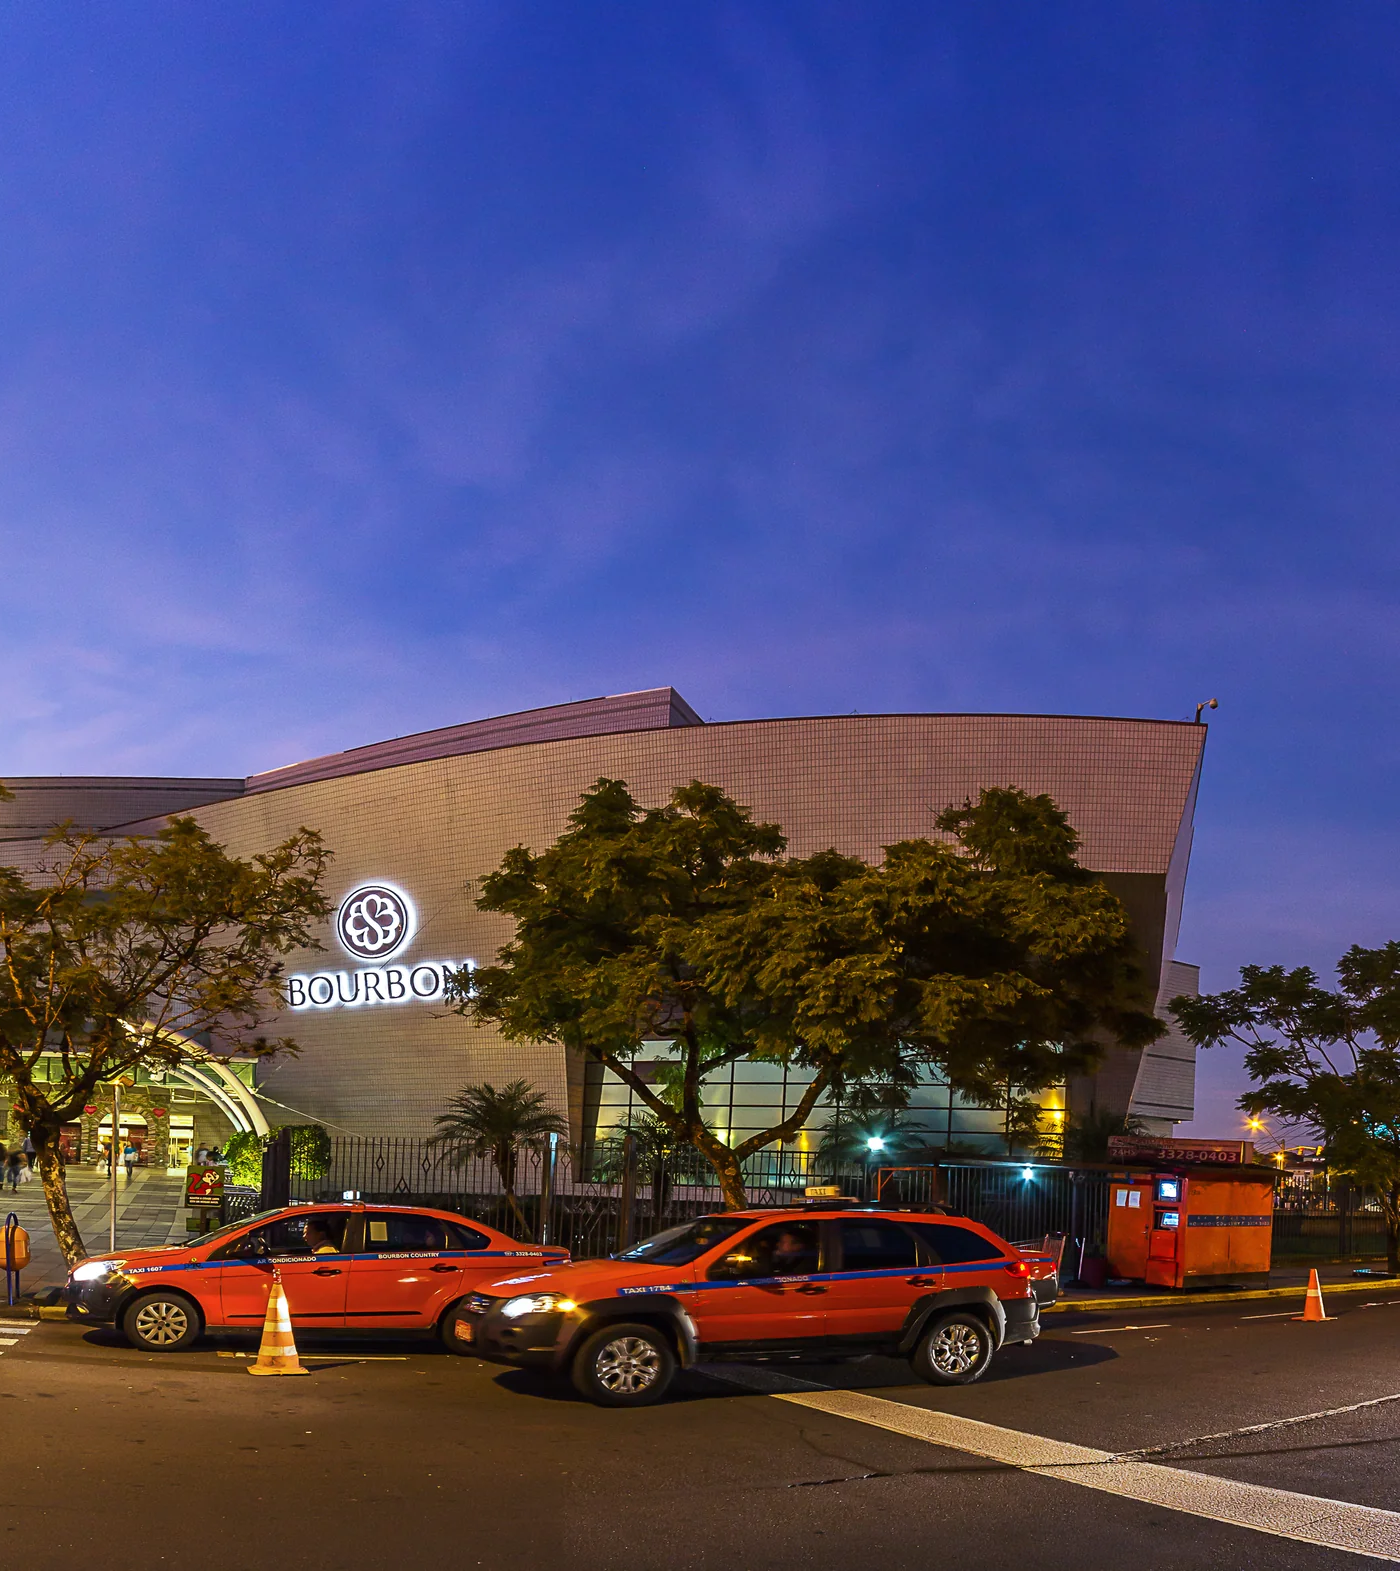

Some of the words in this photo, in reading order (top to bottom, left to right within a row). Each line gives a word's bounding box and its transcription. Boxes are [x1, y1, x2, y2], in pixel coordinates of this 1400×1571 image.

[1157, 1149, 1237, 1161] 3328-0403
[810, 1188, 826, 1196] TAXI
[267, 1256, 317, 1264] CONDICIONADO
